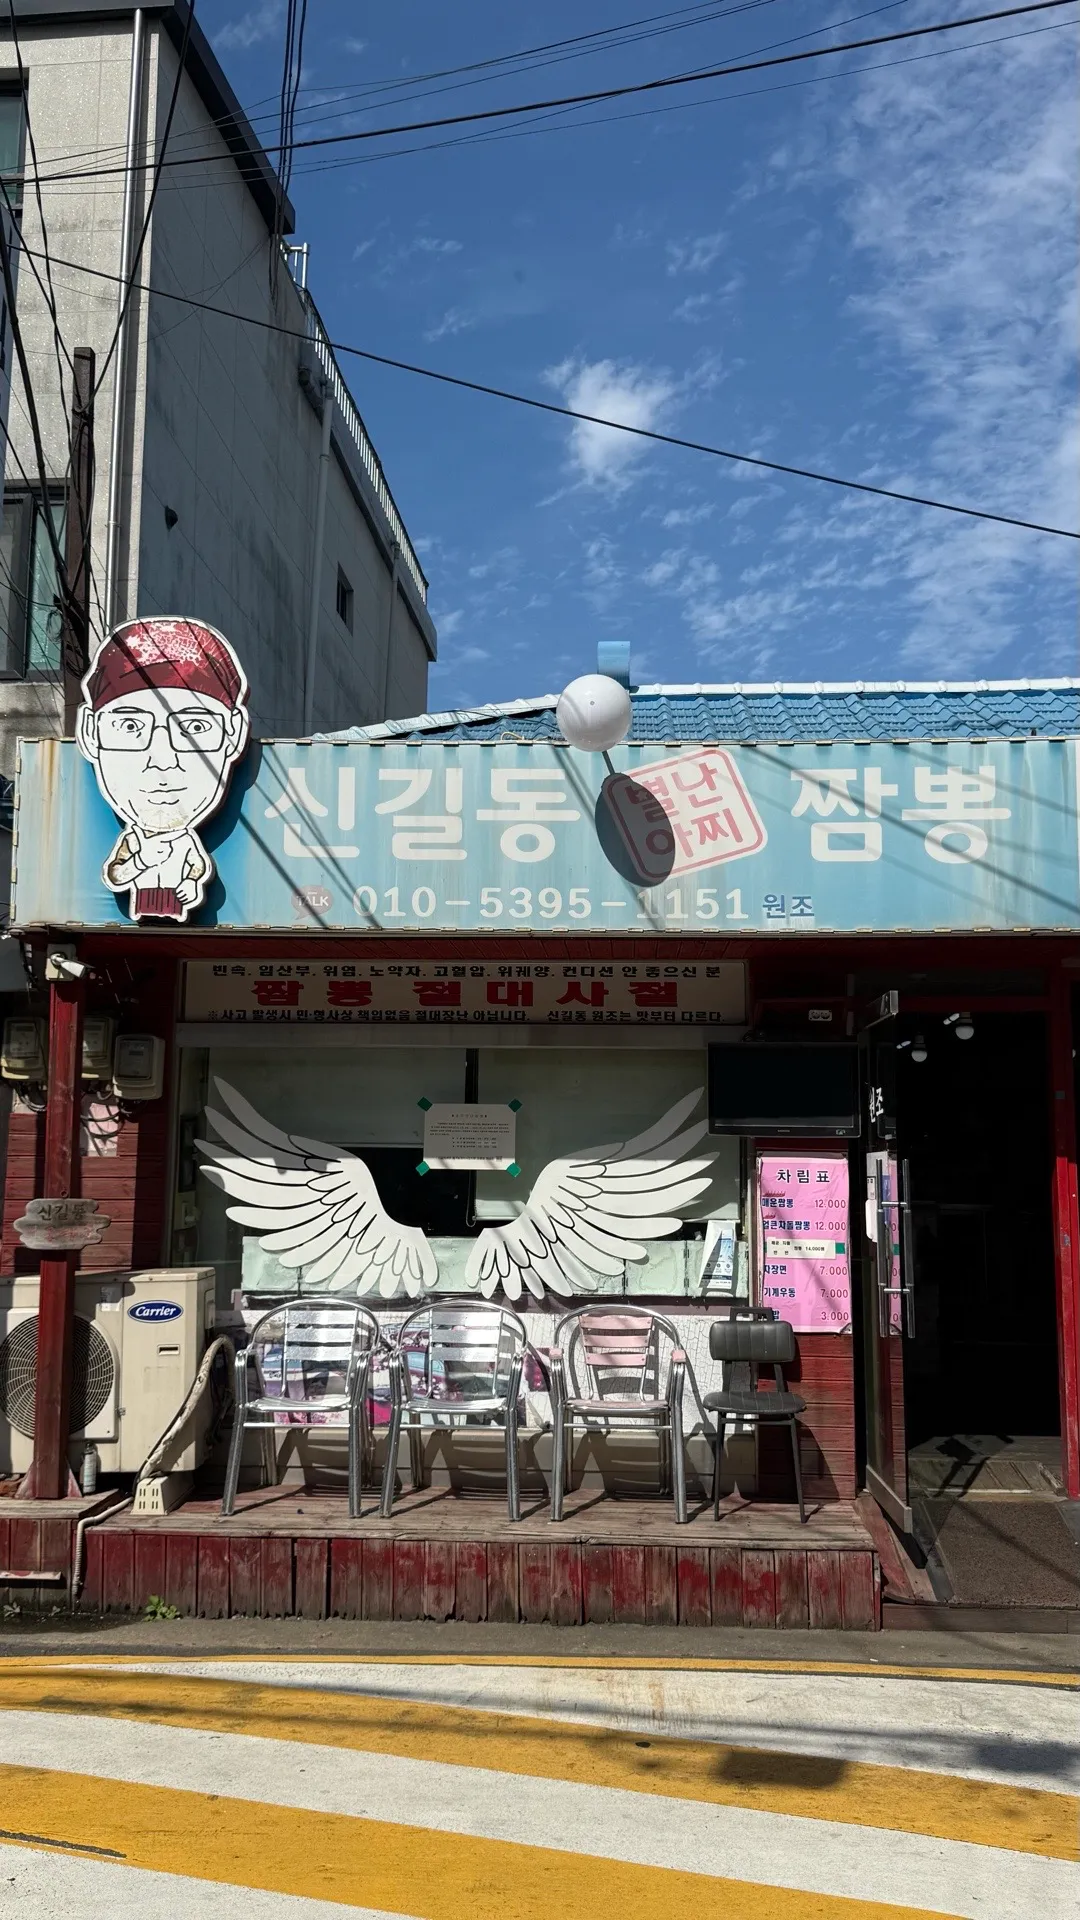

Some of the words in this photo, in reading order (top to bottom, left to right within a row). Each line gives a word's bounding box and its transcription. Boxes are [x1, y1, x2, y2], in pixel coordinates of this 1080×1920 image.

[624, 762, 724, 824] 별난
[264, 766, 581, 863] 신길동
[790, 764, 1012, 864] 짬뽕
[645, 807, 744, 858] 아찌
[296, 895, 329, 907] TALK
[761, 893, 815, 919] 원조
[212, 965, 252, 977] 빈속.
[258, 965, 316, 977] 임산부.
[323, 965, 362, 977] 위염.
[369, 965, 427, 978] 노약자.
[497, 966, 555, 978] 위궤양.
[562, 966, 614, 978] 컨디션
[621, 966, 638, 978] 안
[645, 966, 697, 978] 좋으신
[705, 966, 721, 978] 분
[251, 980, 374, 1006] 짬뽕
[252, 1009, 291, 1021] 발생시
[473, 1010, 530, 1023] 아닙니다.
[547, 1011, 587, 1023] 신길동
[592, 1011, 631, 1023] 원조는
[636, 1011, 676, 1023] 맛부터
[681, 1011, 725, 1023] 다르다.
[777, 1169, 831, 1184] 차림표
[814, 1199, 847, 1209] 12.000
[37, 1203, 86, 1221] 신길동
[814, 1221, 847, 1231] 12.000
[819, 1266, 848, 1276] 7.000
[820, 1288, 849, 1298] 7.000
[135, 1305, 177, 1317] Carrier
[821, 1311, 849, 1321] 3.000
